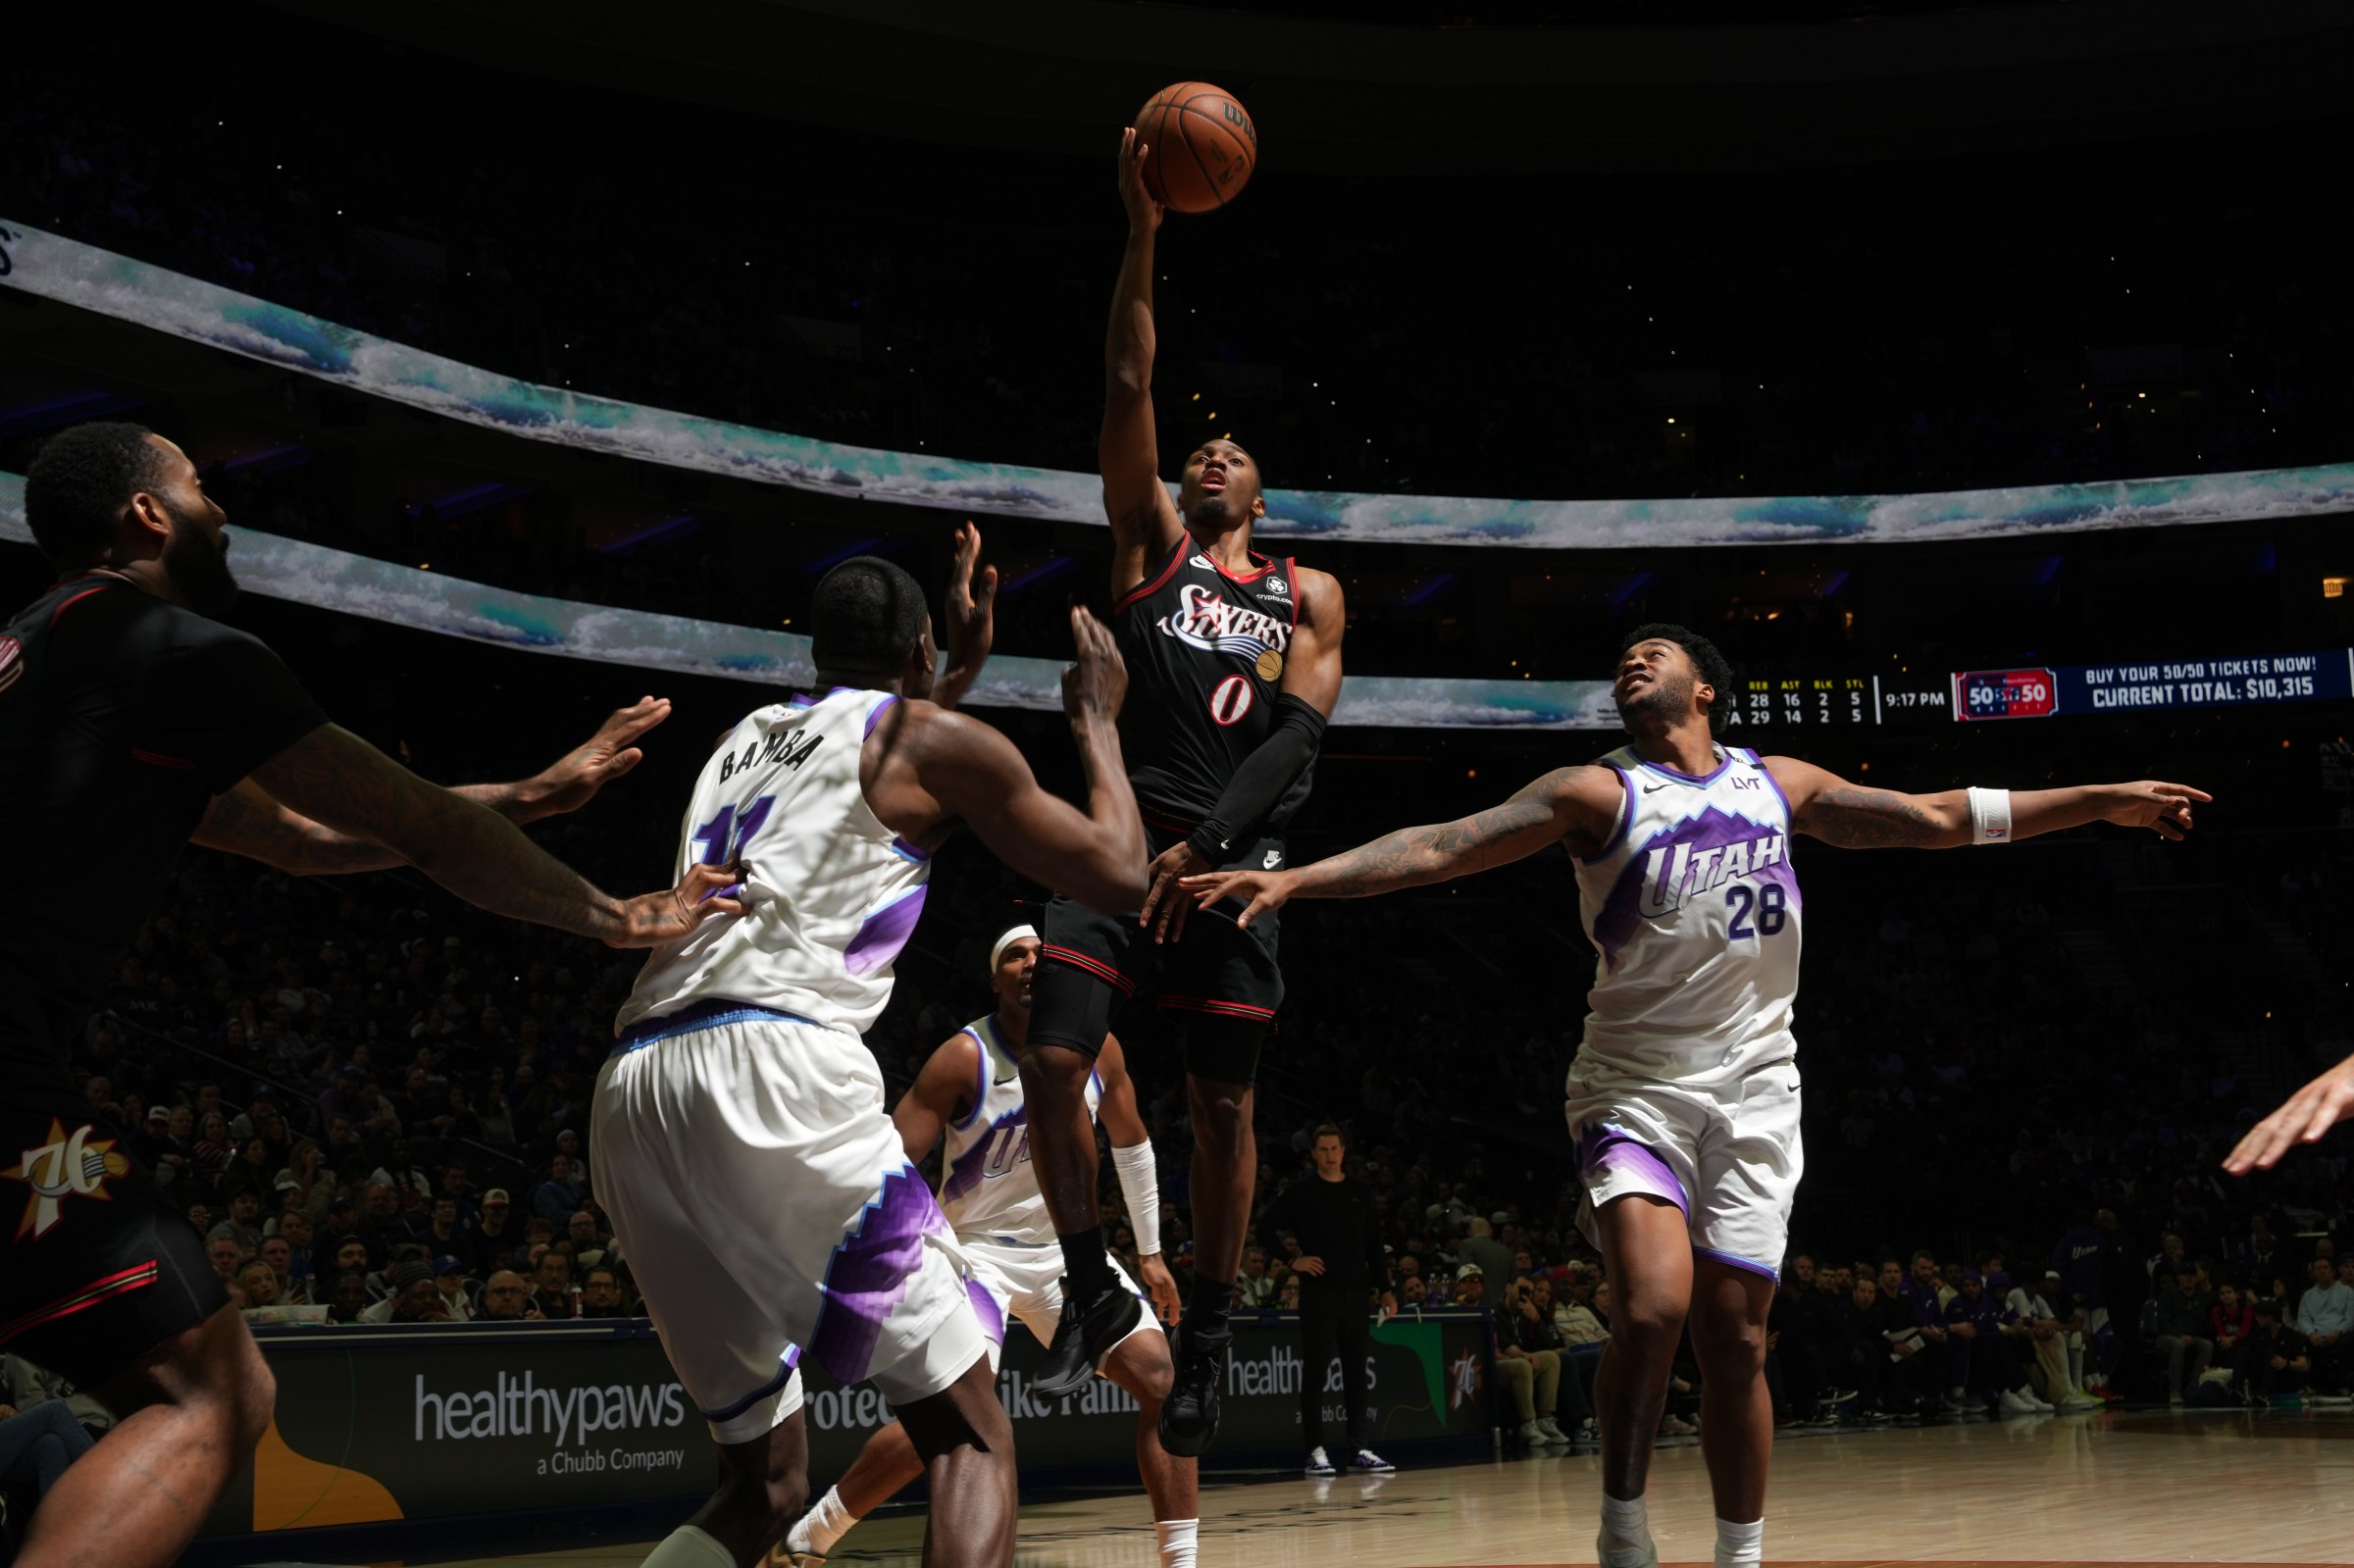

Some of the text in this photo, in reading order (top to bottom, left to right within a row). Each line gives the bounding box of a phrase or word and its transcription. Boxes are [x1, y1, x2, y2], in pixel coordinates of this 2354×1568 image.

[2085, 656, 2317, 684] BUY YOUR 50/50 TICKETS NOW!
[1749, 679, 1865, 691] REB AST BLK STL
[1969, 685, 1994, 706] 50
[2021, 683, 2046, 703] 50
[2093, 676, 2315, 708] CURRENT TOTAL: $10,315
[1209, 674, 1254, 727] 0
[1750, 693, 1769, 708] 28
[1783, 693, 1801, 708] 16
[1818, 692, 1828, 707] 2
[1851, 691, 1861, 706] 5
[1885, 692, 1945, 708] 9:17 PM
[1751, 711, 1770, 725] 29
[1784, 710, 1802, 725] 14
[1820, 709, 1829, 724] 2
[1852, 708, 1862, 723] 5
[719, 730, 825, 785] BAMBA
[1638, 834, 1784, 919] UTAH
[1725, 883, 1786, 941] 28
[414, 1370, 686, 1447] healthypaws
[537, 1447, 685, 1475] a Chubb Company
